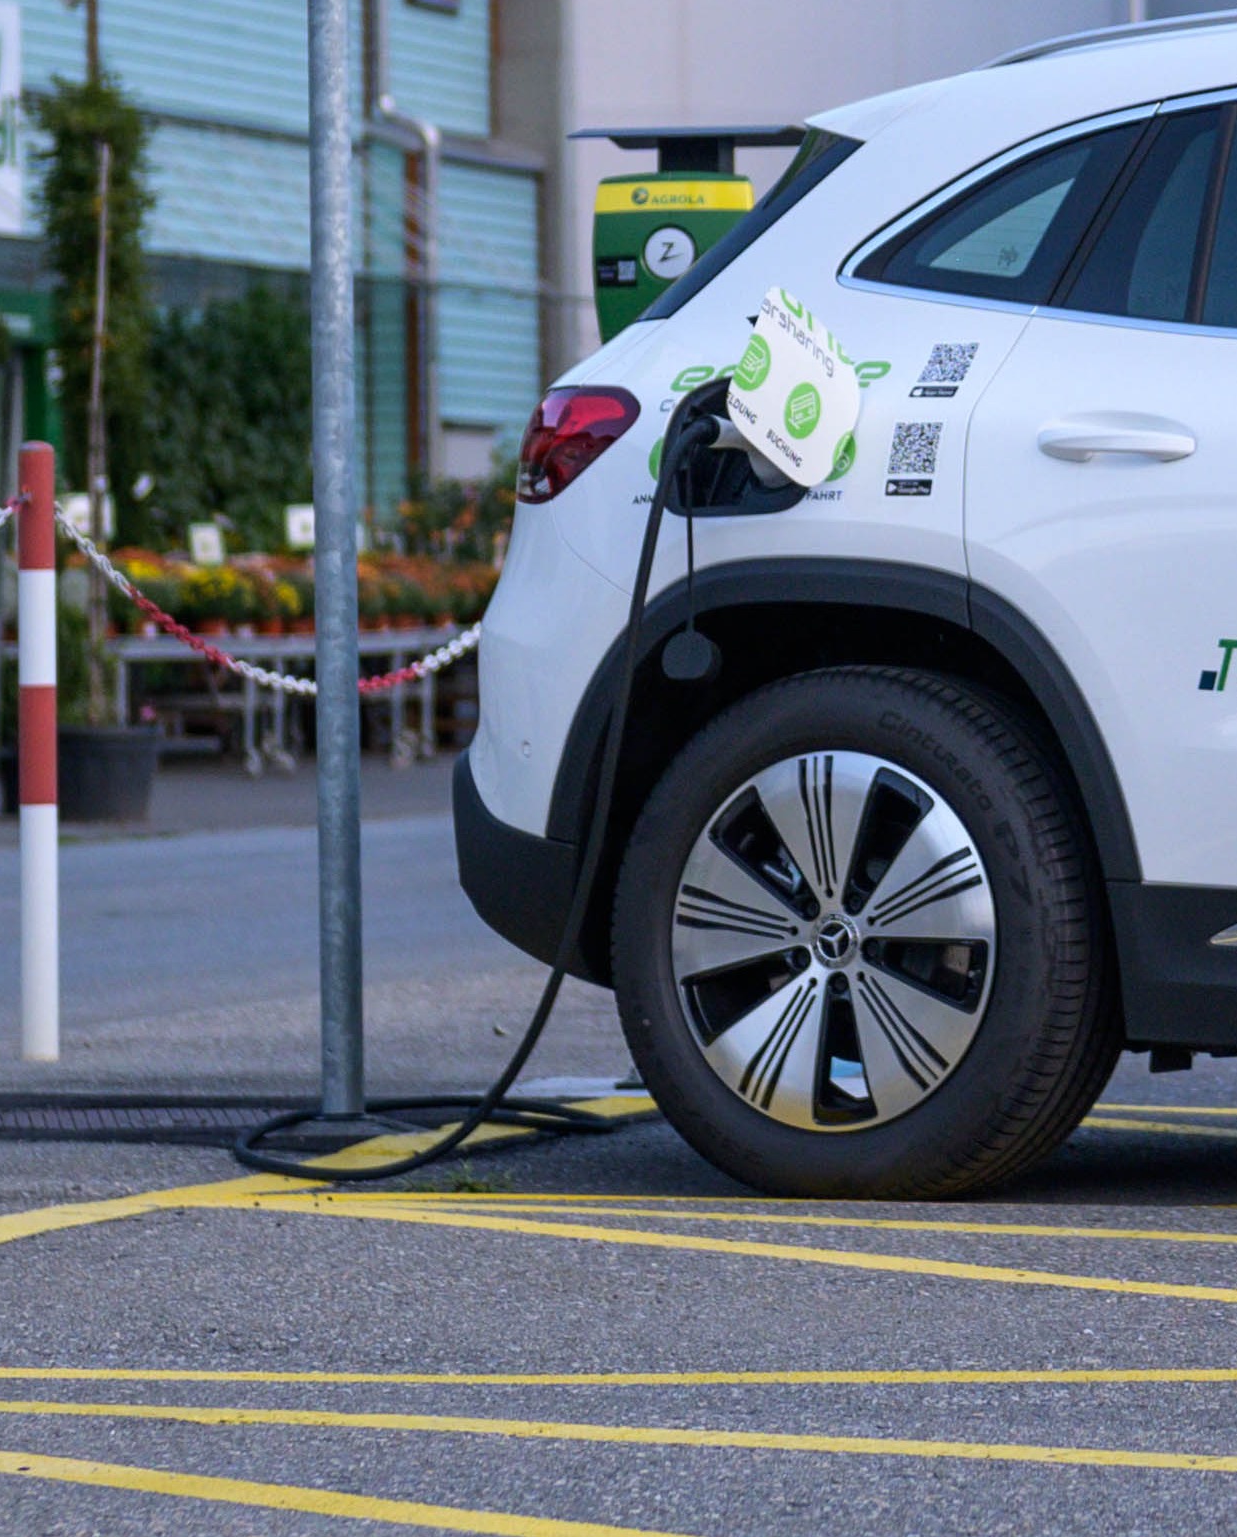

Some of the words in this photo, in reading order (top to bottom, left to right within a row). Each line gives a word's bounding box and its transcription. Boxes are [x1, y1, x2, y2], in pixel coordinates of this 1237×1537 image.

[651, 194, 705, 205] AGROLA
[766, 428, 804, 468] BUCHUNG
[806, 489, 844, 501] FAHRT
[879, 710, 993, 811] Cinturato
